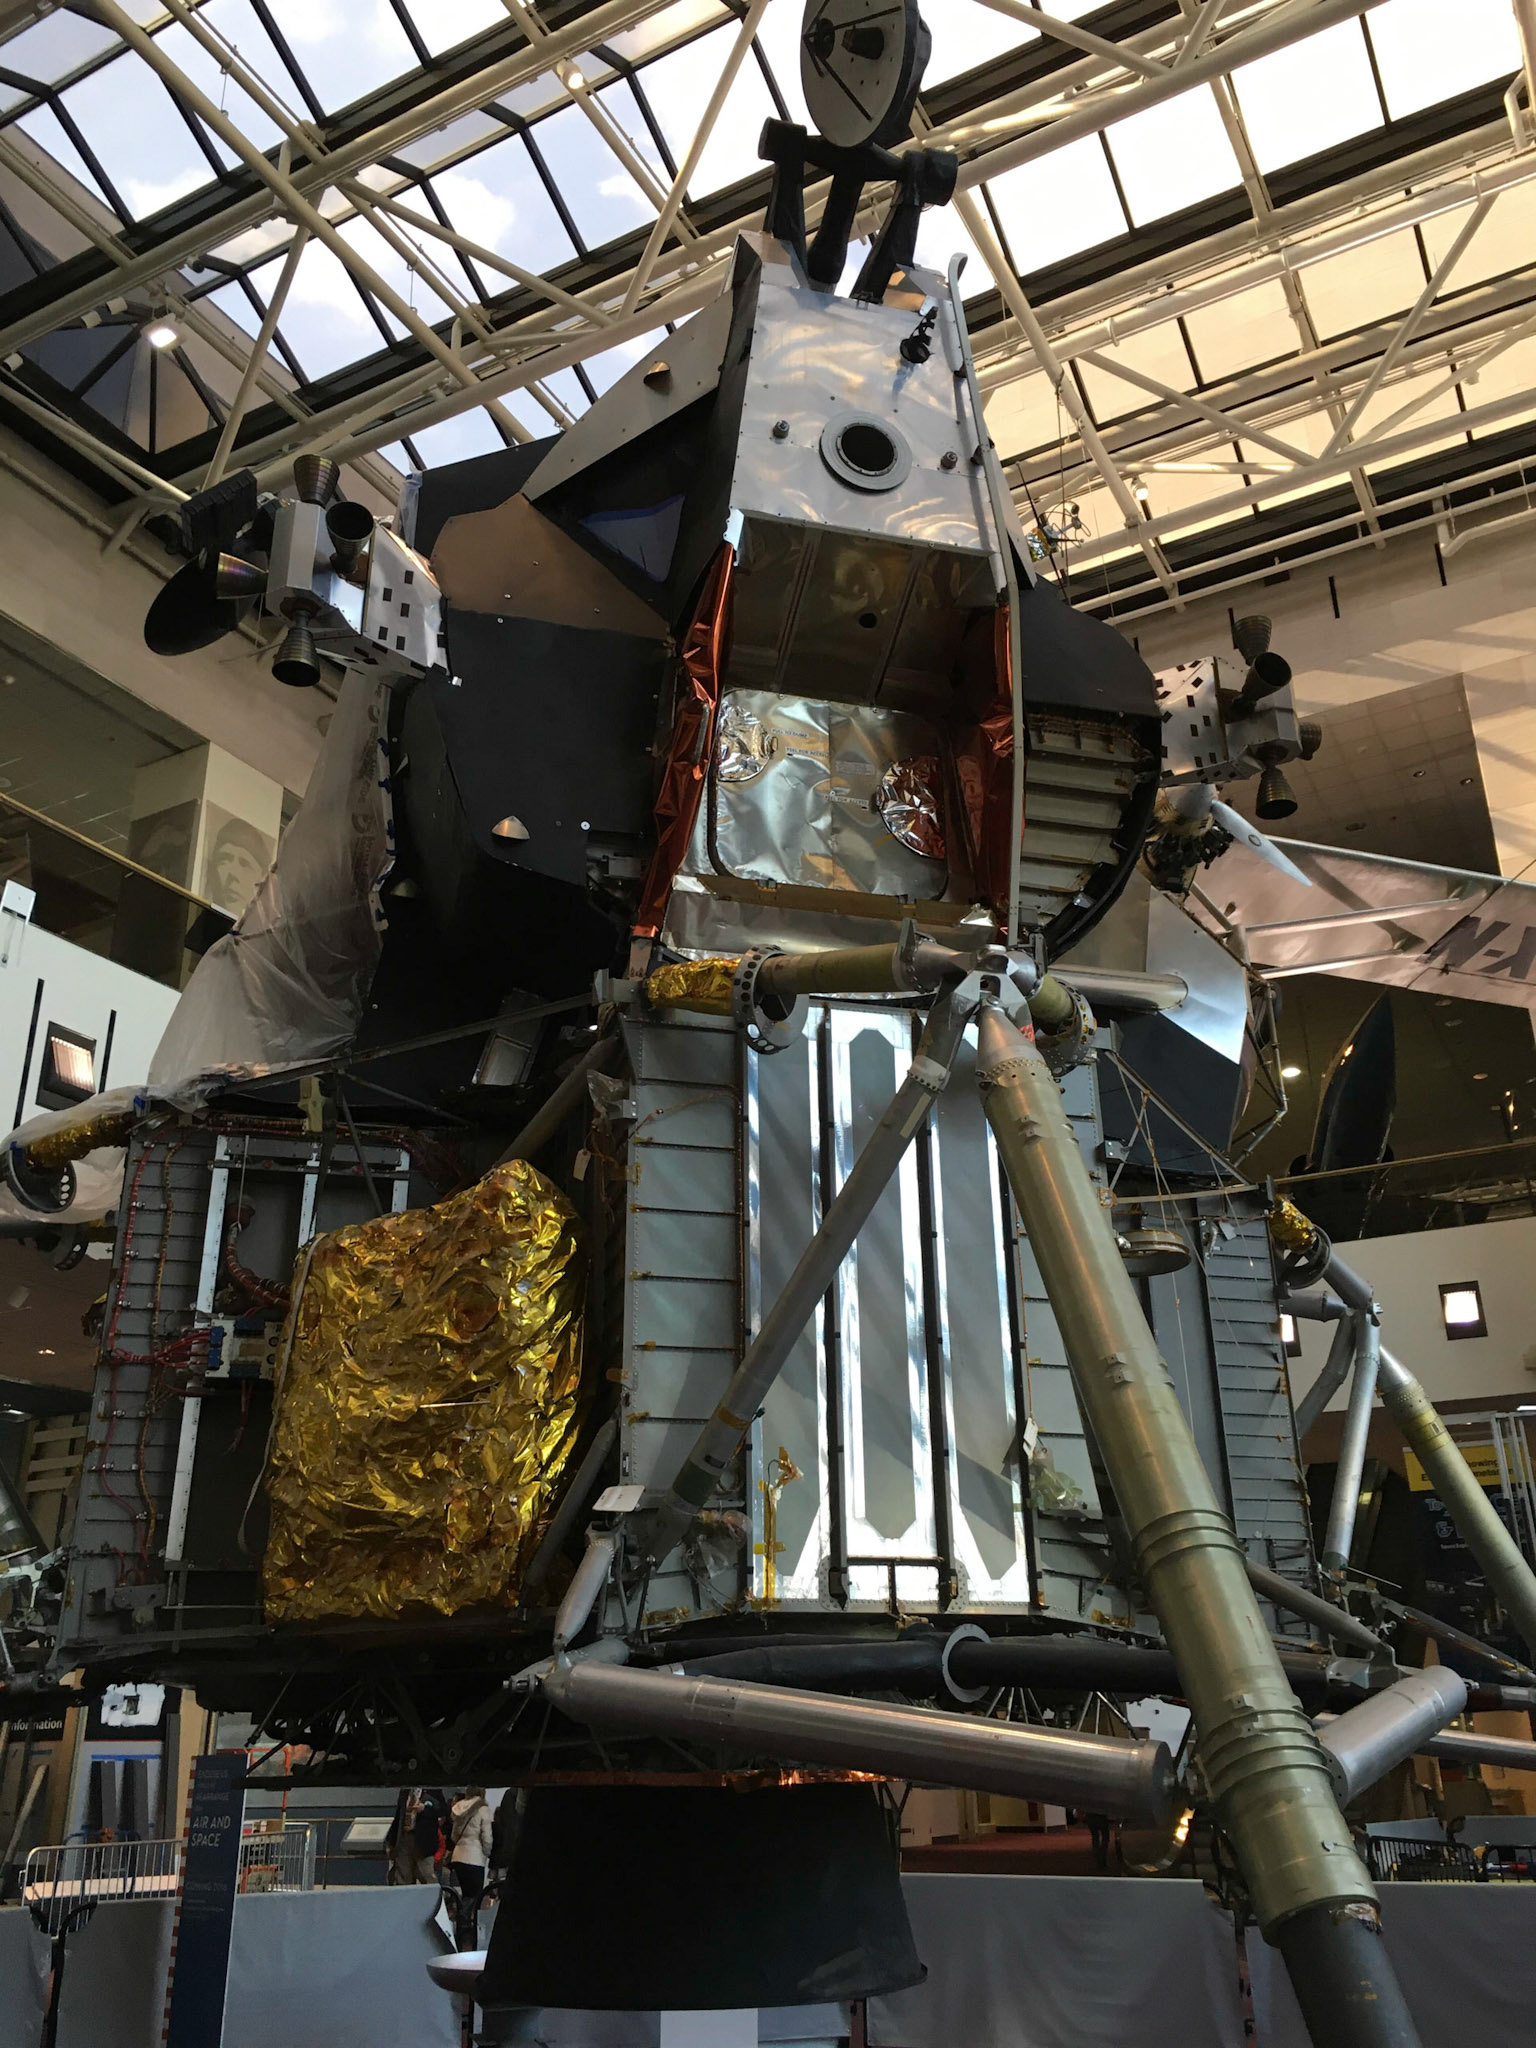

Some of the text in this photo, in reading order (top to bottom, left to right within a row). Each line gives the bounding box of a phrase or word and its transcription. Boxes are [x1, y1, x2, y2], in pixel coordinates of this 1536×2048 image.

[192, 1815, 231, 1829] AIR AND
[191, 1832, 221, 1847] SPACE
